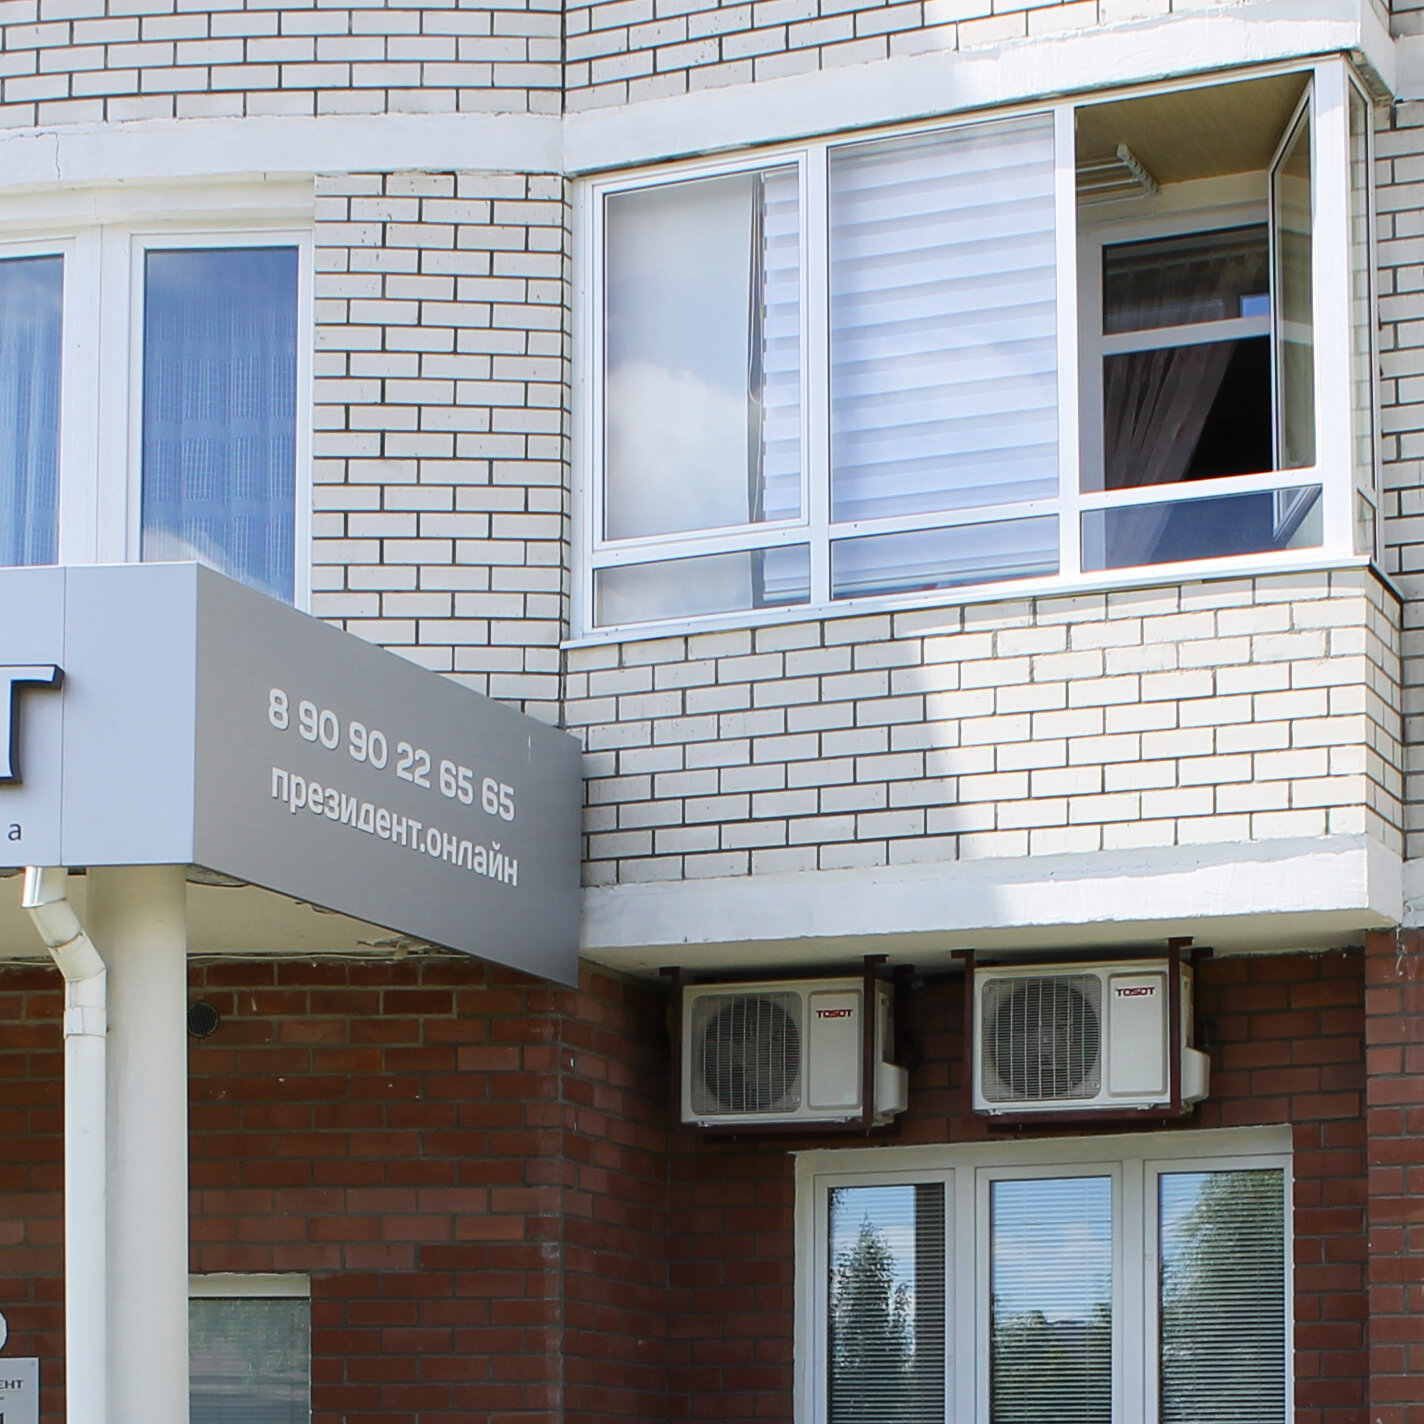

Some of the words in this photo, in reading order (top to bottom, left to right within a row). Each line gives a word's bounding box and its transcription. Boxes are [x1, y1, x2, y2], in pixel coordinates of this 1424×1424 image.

[269, 687, 289, 730] 8
[298, 700, 340, 750] 90
[348, 721, 388, 769] 90
[396, 741, 431, 789] 22
[439, 759, 474, 805] 65
[482, 777, 515, 822] 65
[271, 766, 518, 887] президент.онлайн
[816, 1009, 854, 1018] TOSOT
[1115, 986, 1156, 997] TOSOT
